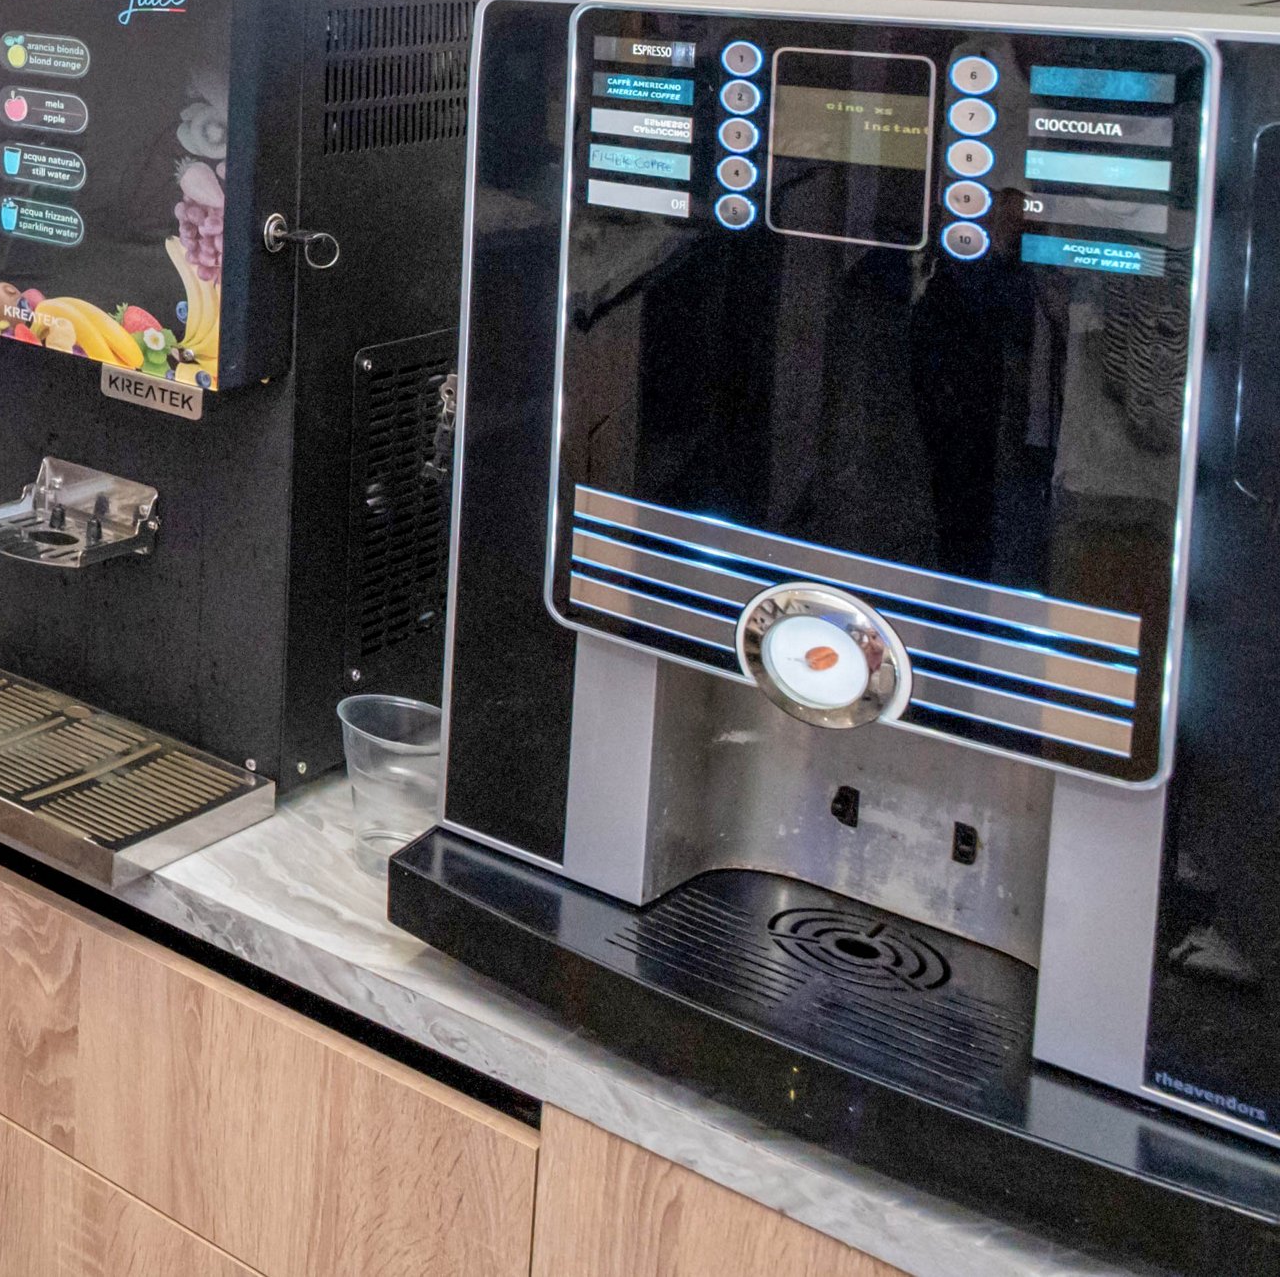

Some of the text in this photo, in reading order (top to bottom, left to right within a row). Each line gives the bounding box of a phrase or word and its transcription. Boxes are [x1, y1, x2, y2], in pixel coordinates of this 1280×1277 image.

[26, 43, 84, 55] arancia bionda
[632, 43, 672, 58] ESPRESSO
[29, 56, 82, 71] blond orange
[739, 54, 744, 63] 1
[970, 71, 977, 80] 6
[607, 77, 681, 91] CAFFÈ AMERICANO
[607, 87, 681, 101] AMERICAN COFFEE
[737, 93, 744, 101] 2
[45, 100, 65, 110] mela
[43, 114, 66, 124] apple
[968, 112, 975, 121] 7
[1035, 117, 1123, 137] CIOCCOLATA
[735, 131, 742, 140] 3
[23, 152, 80, 168] acqua naturale
[966, 153, 973, 162] 8
[32, 168, 71, 181] still water
[734, 169, 740, 177] 4
[963, 195, 970, 203] 9
[20, 207, 79, 225] acqua frizzante
[732, 207, 738, 215] 5
[19, 221, 79, 238] sparkling water
[959, 235, 971, 245] 10
[1062, 244, 1142, 260] ACQUA CALDA
[1073, 256, 1141, 271] HOT WATER
[3, 304, 60, 327] KREATEK
[108, 374, 194, 412] KREATEK
